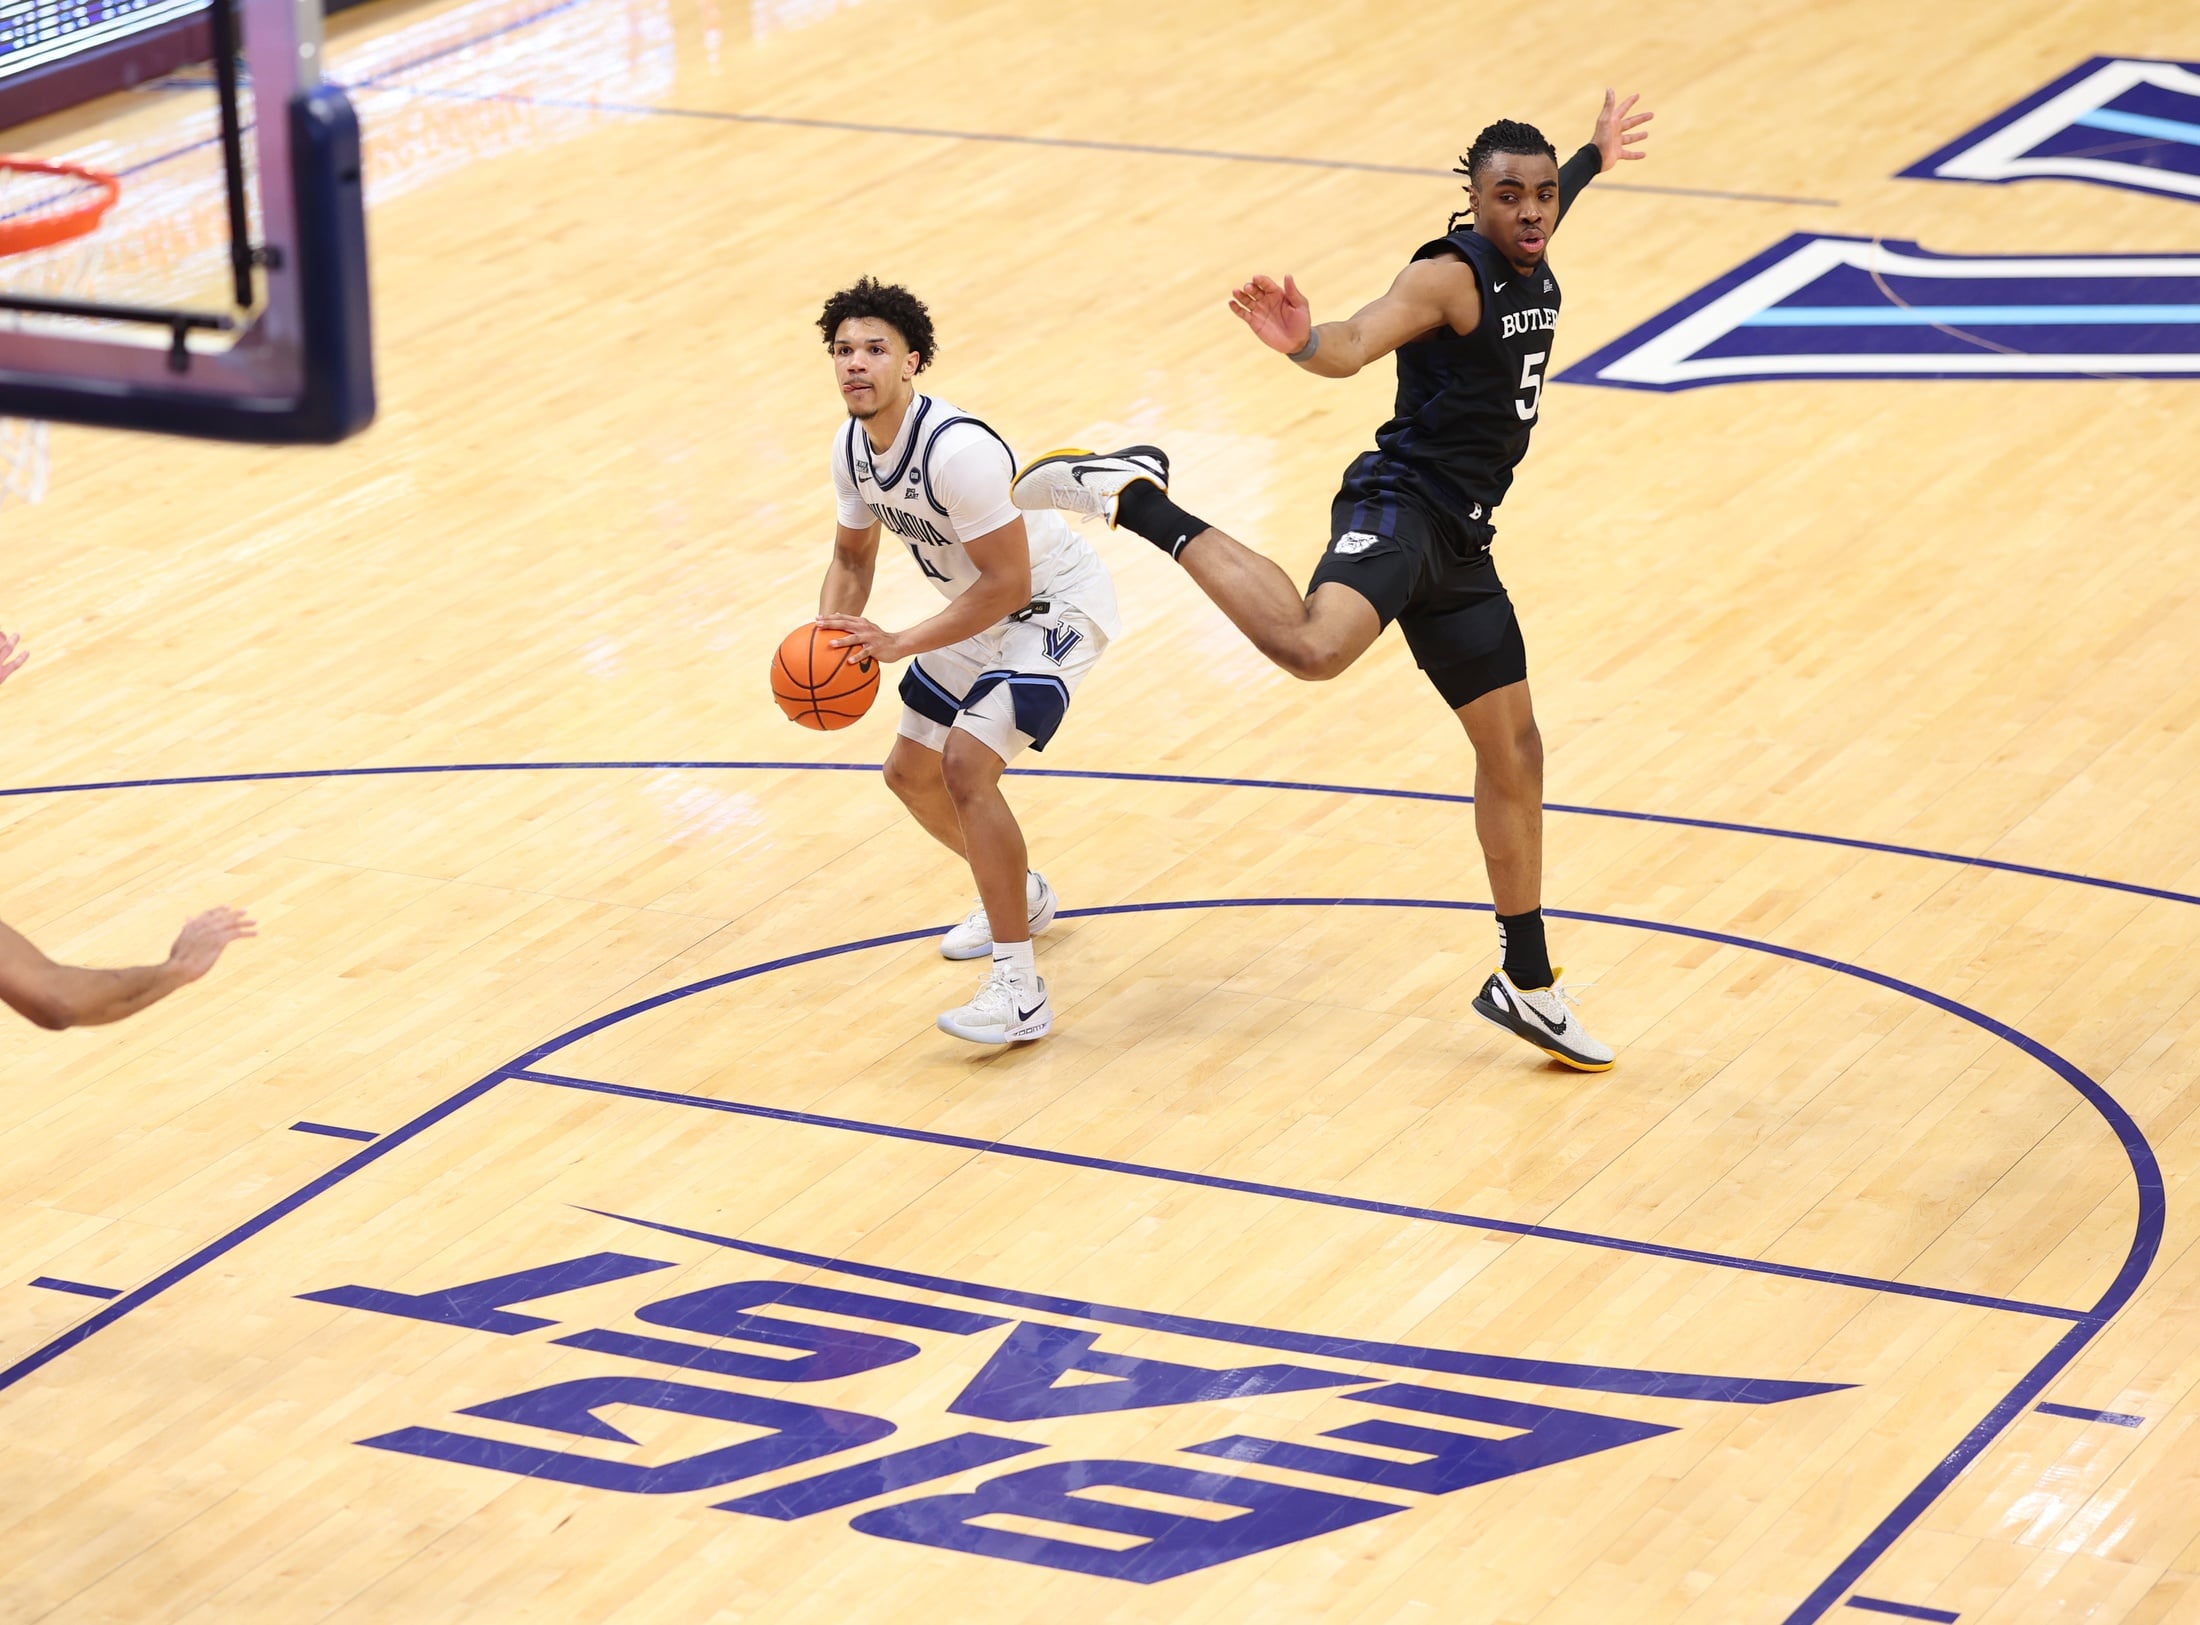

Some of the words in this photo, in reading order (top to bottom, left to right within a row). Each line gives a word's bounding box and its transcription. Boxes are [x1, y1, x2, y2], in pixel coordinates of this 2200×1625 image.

[1515, 351, 1546, 421] 5
[291, 1252, 1683, 1496] EAST
[353, 1376, 1413, 1584] BIG
